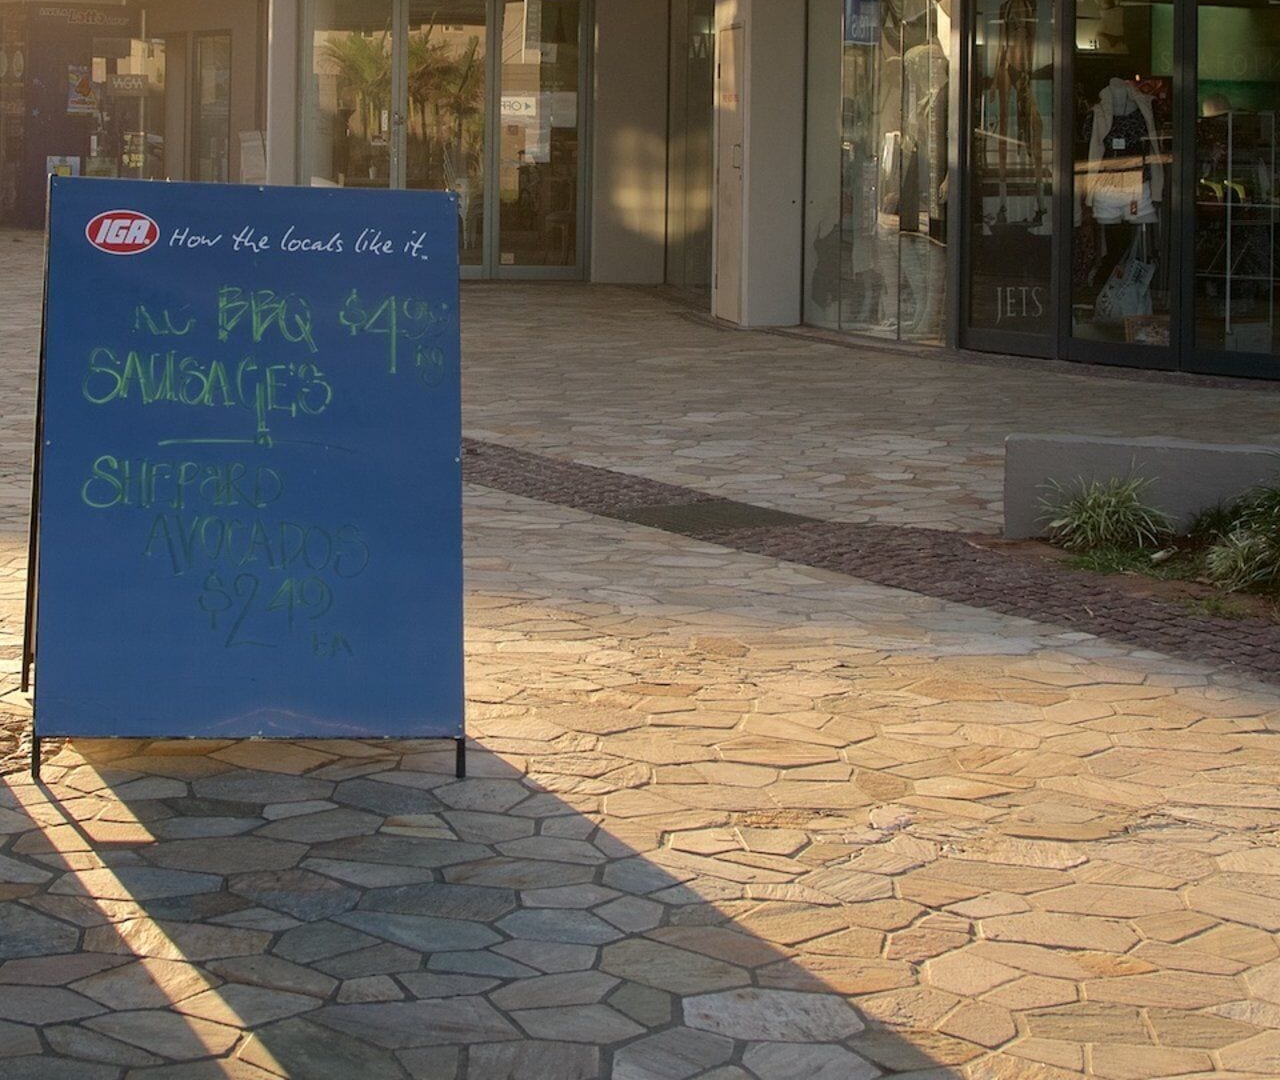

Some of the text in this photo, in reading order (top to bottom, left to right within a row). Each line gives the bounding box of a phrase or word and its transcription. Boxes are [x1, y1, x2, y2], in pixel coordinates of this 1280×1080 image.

[95, 218, 152, 245] IGA
[169, 226, 224, 248] How
[232, 225, 270, 252] the
[280, 225, 344, 253] locals
[355, 226, 394, 256] like
[218, 286, 319, 353] BBQ
[995, 286, 1043, 327] JETS
